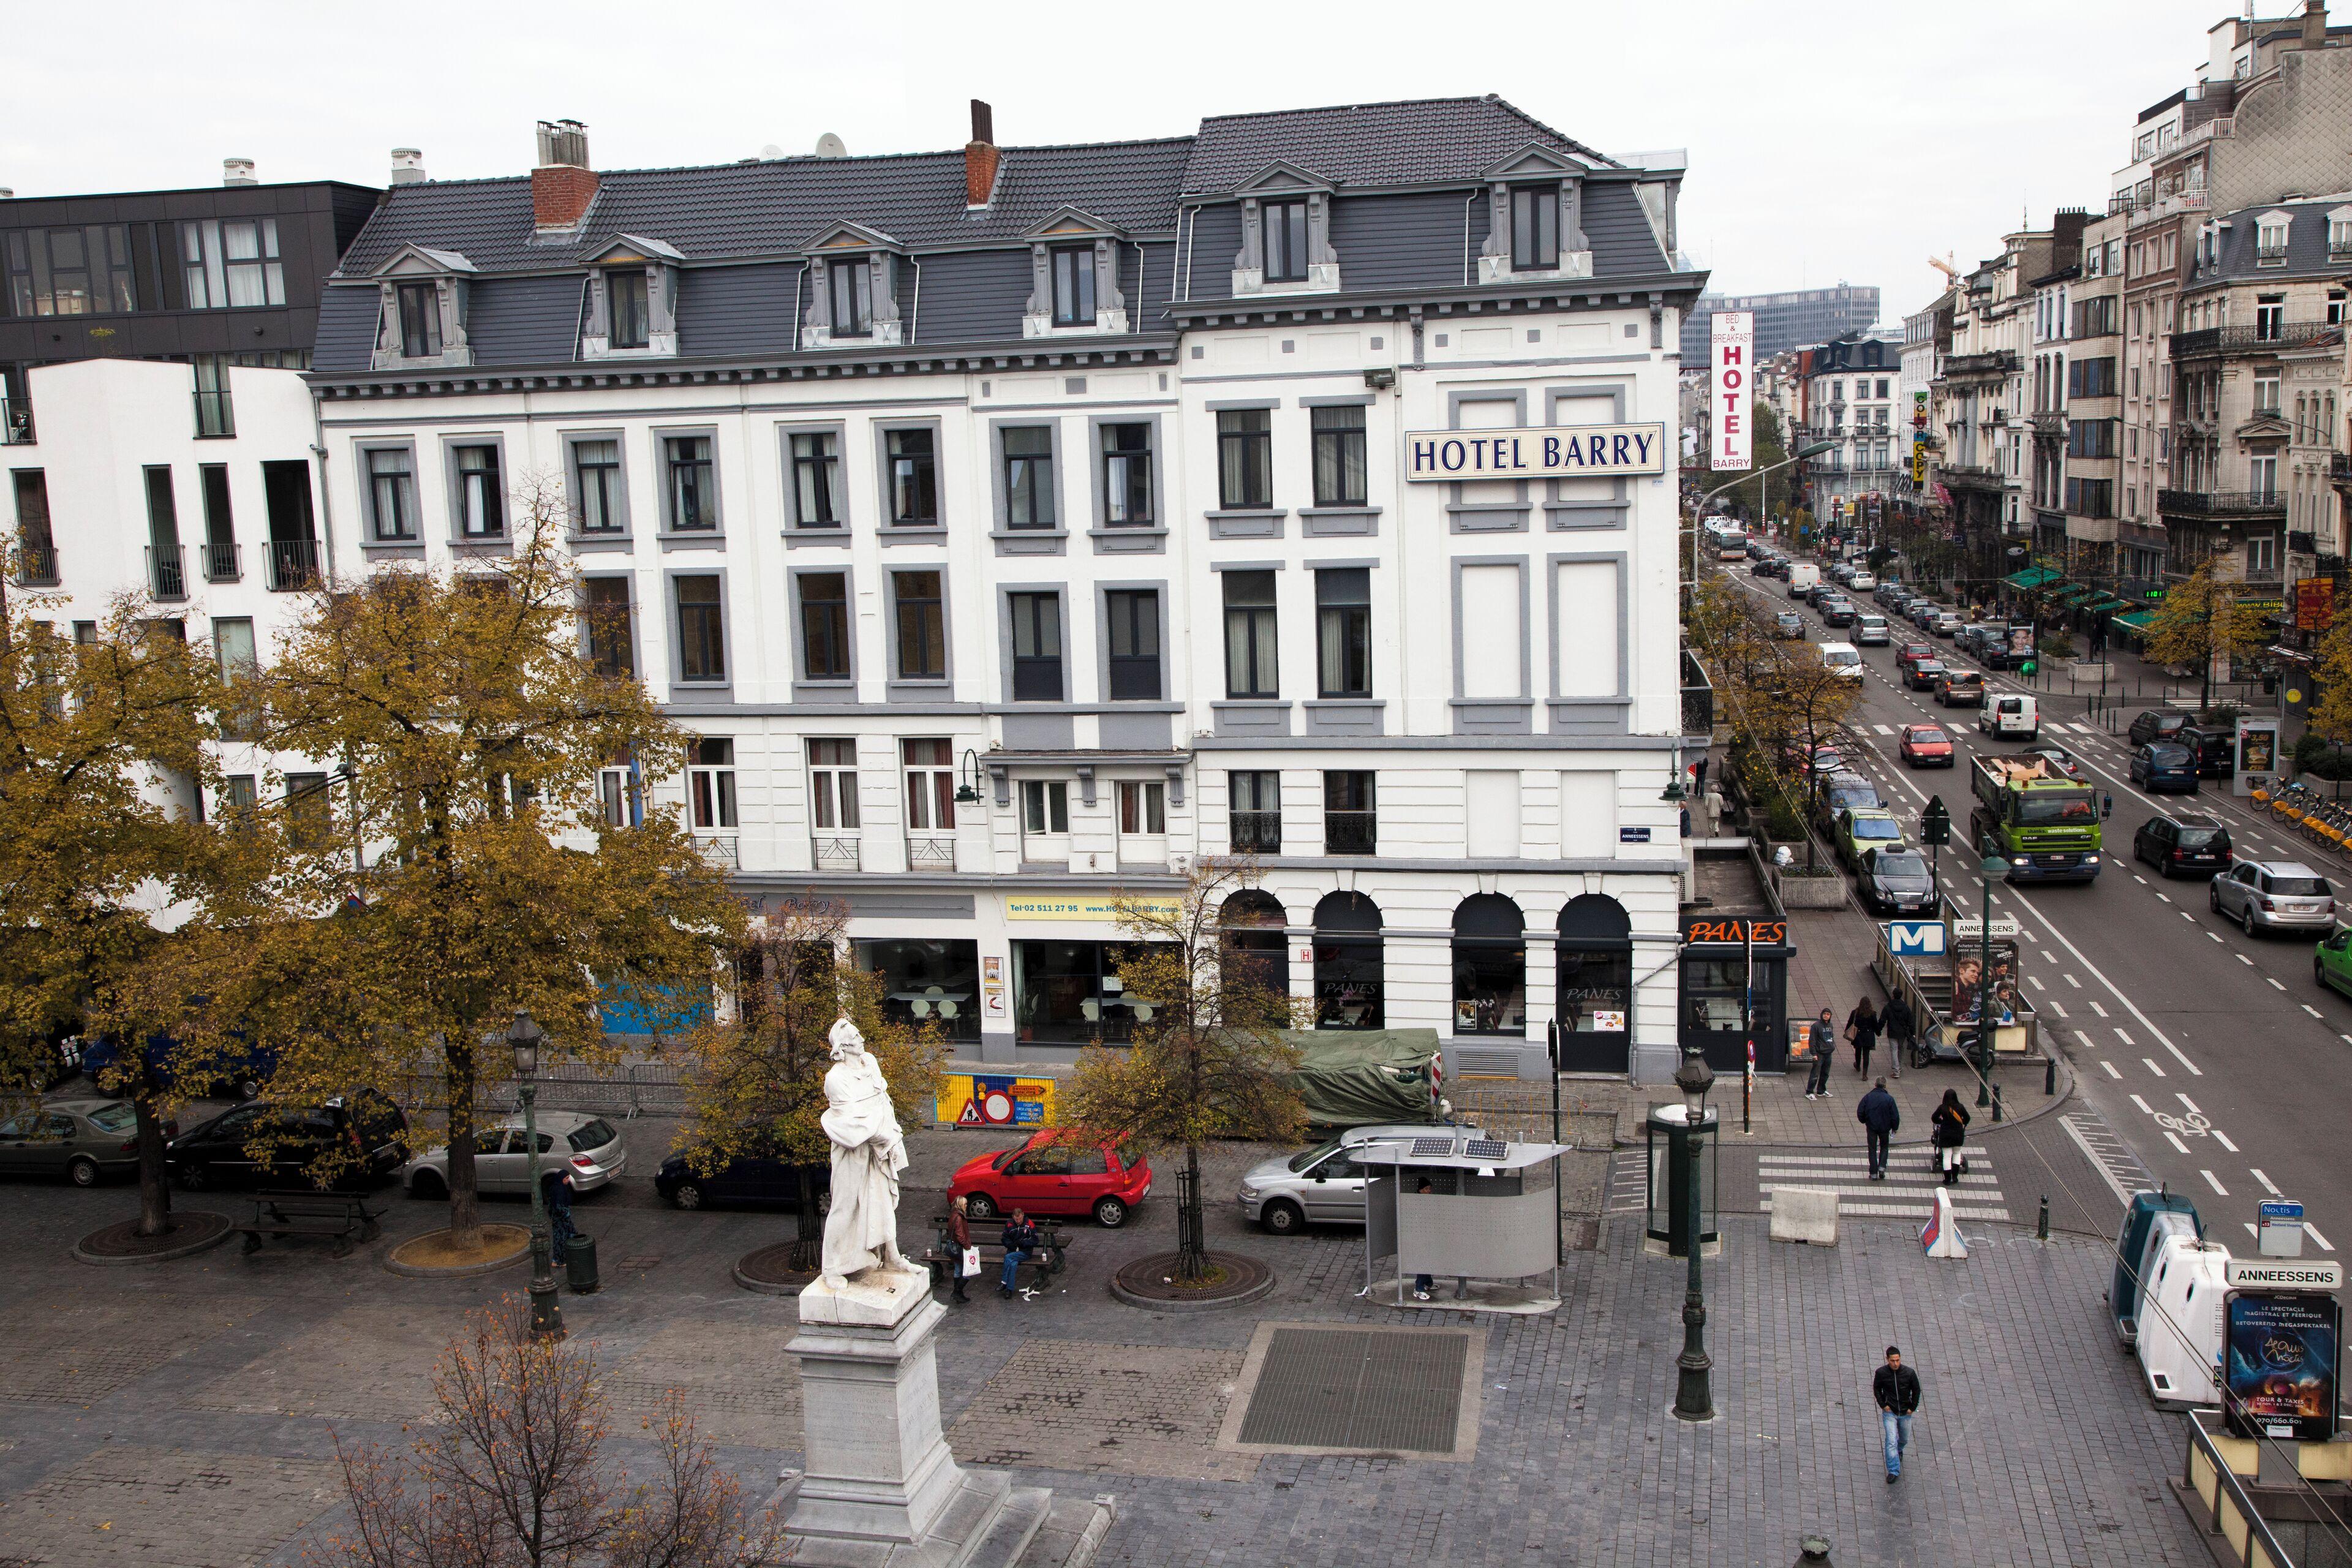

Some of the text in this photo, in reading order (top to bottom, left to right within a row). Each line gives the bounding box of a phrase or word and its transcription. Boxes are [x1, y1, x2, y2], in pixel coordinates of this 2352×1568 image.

[1725, 314, 1740, 324] BED
[1713, 333, 1752, 343] BREAKFAST
[1723, 345, 1742, 456] HOTEL
[1413, 431, 1657, 473] HOTEL BARRY
[1713, 459, 1751, 468] BARRY
[1689, 921, 1787, 941] PANES
[1302, 951, 1310, 960] H
[1324, 982, 1378, 994] PANES
[1566, 988, 1623, 1000] PANES
[2237, 1270, 2334, 1283] ANNEESSENS
